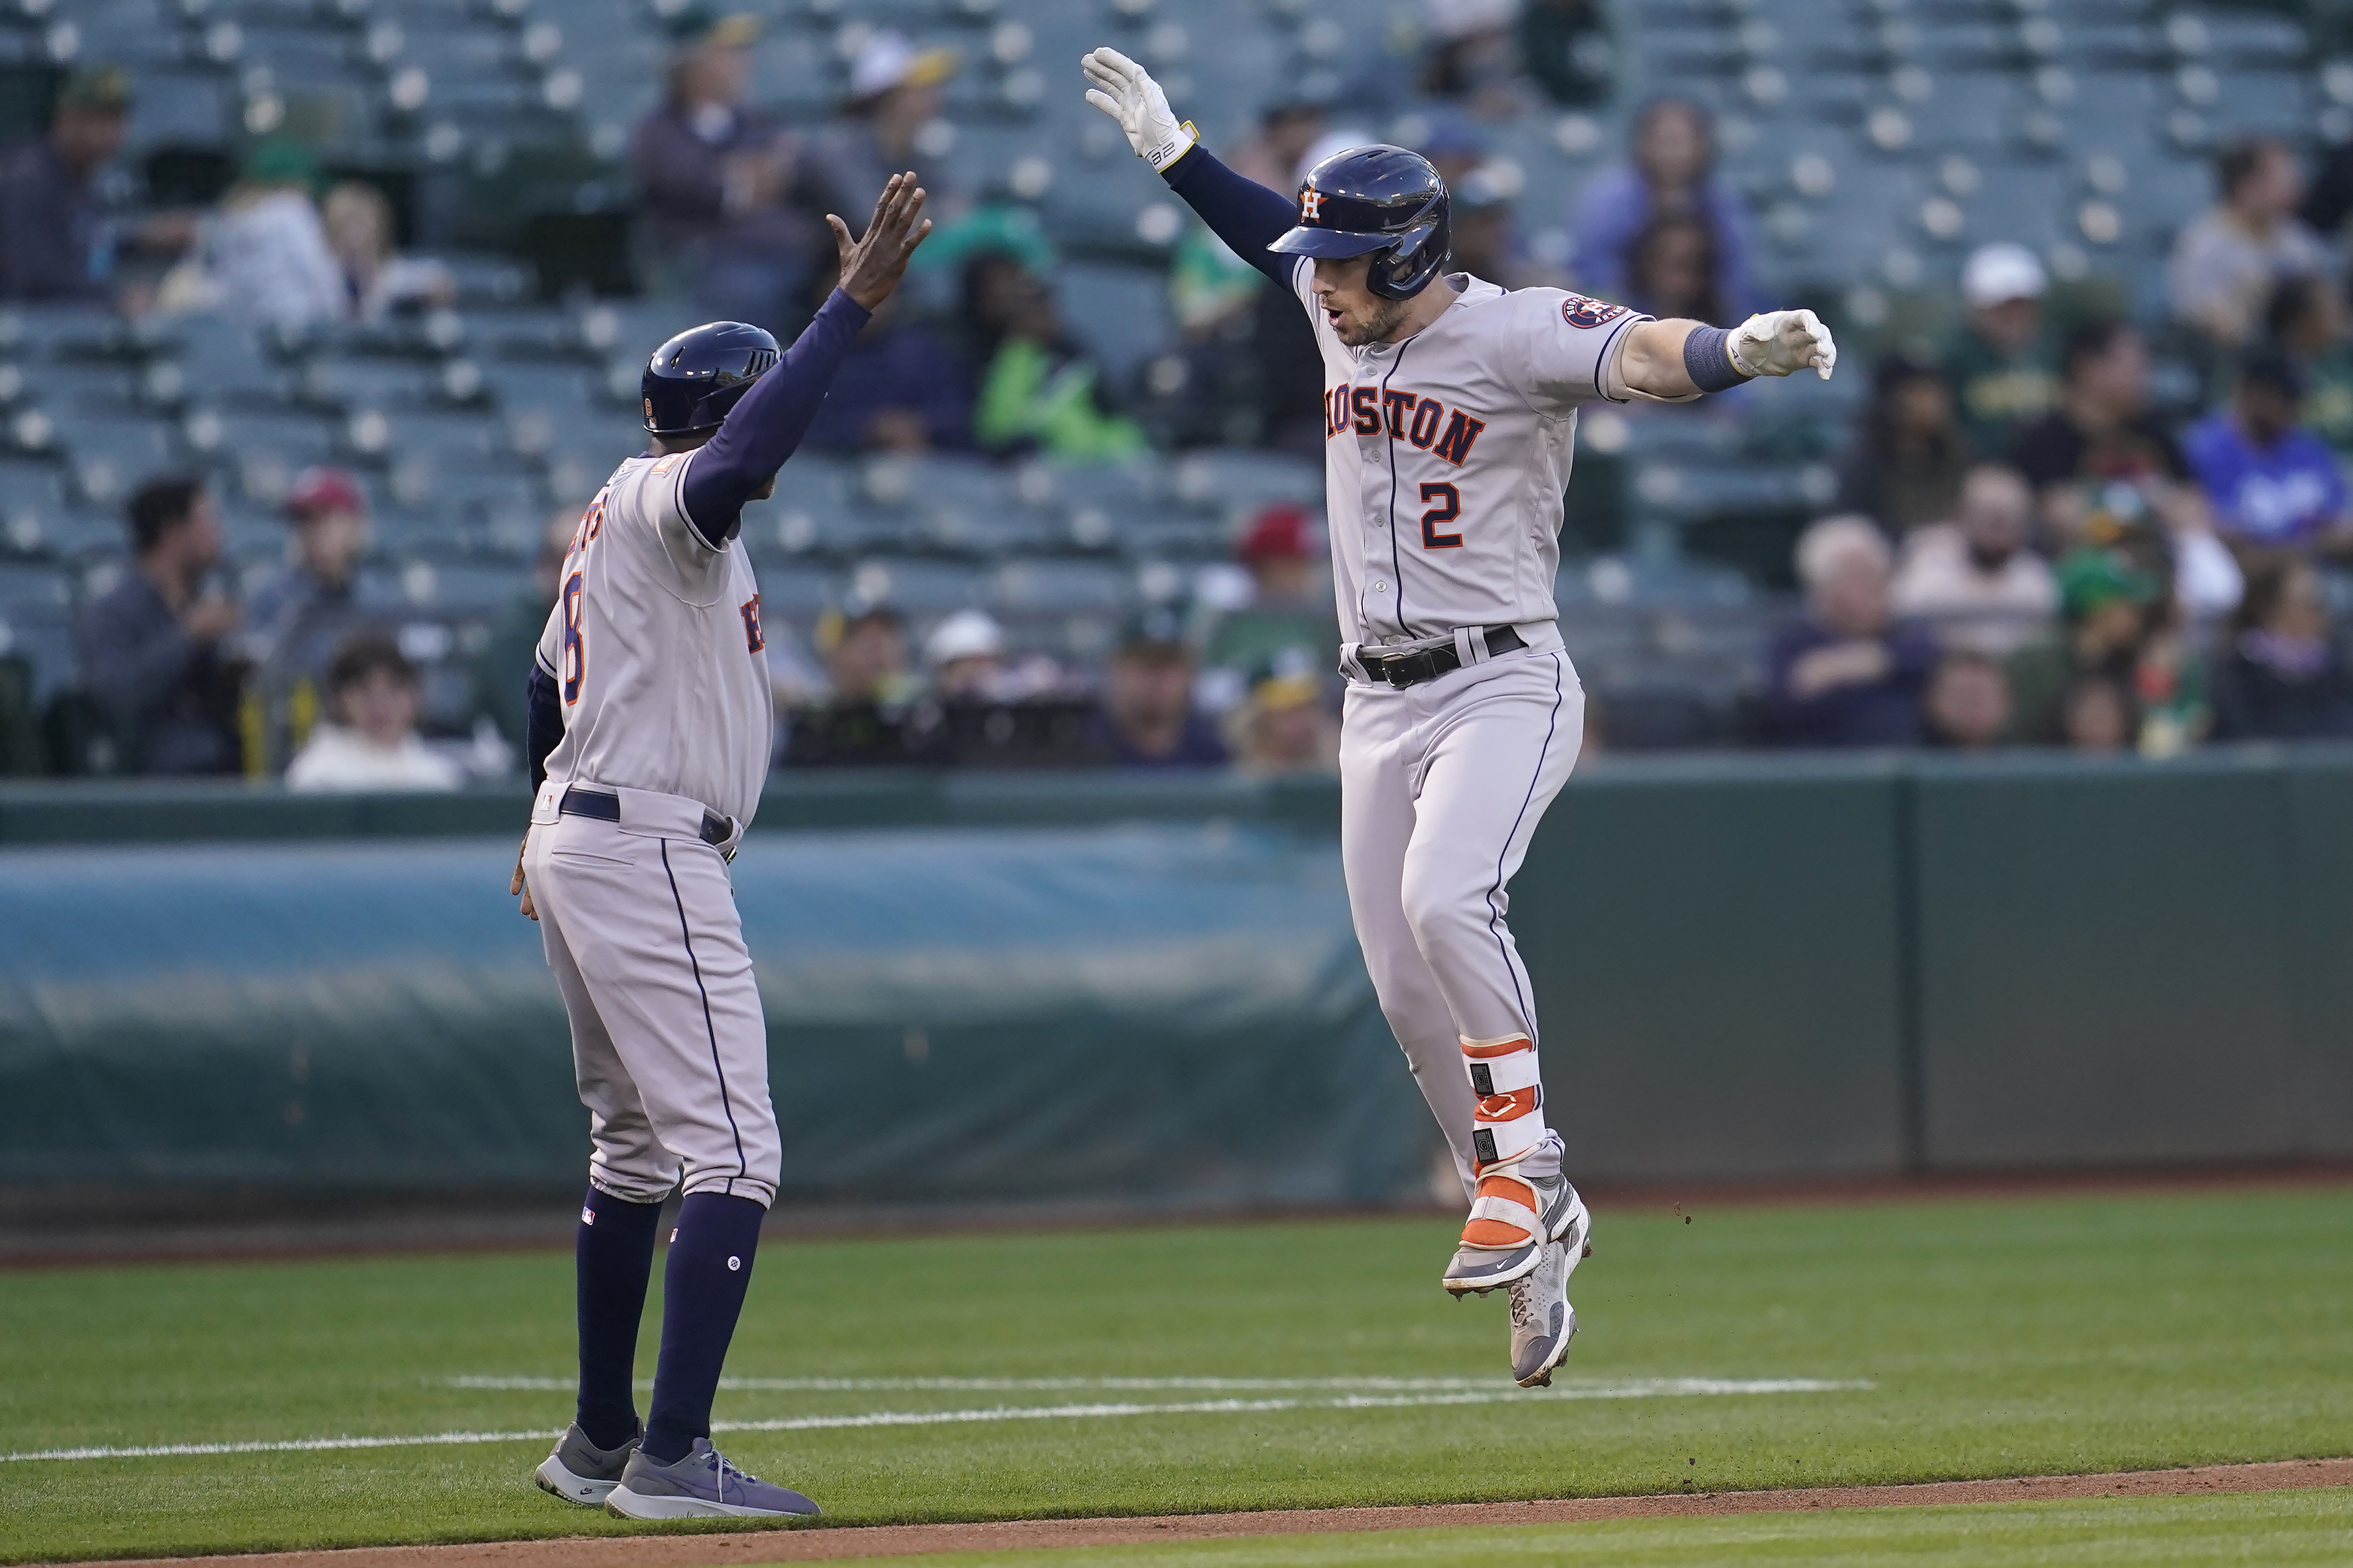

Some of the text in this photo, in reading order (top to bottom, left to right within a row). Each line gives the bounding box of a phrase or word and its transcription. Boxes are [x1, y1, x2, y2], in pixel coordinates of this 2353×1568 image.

[1323, 383, 1486, 467] OSTON
[1419, 482, 1463, 549] 2
[563, 570, 586, 707] 8
